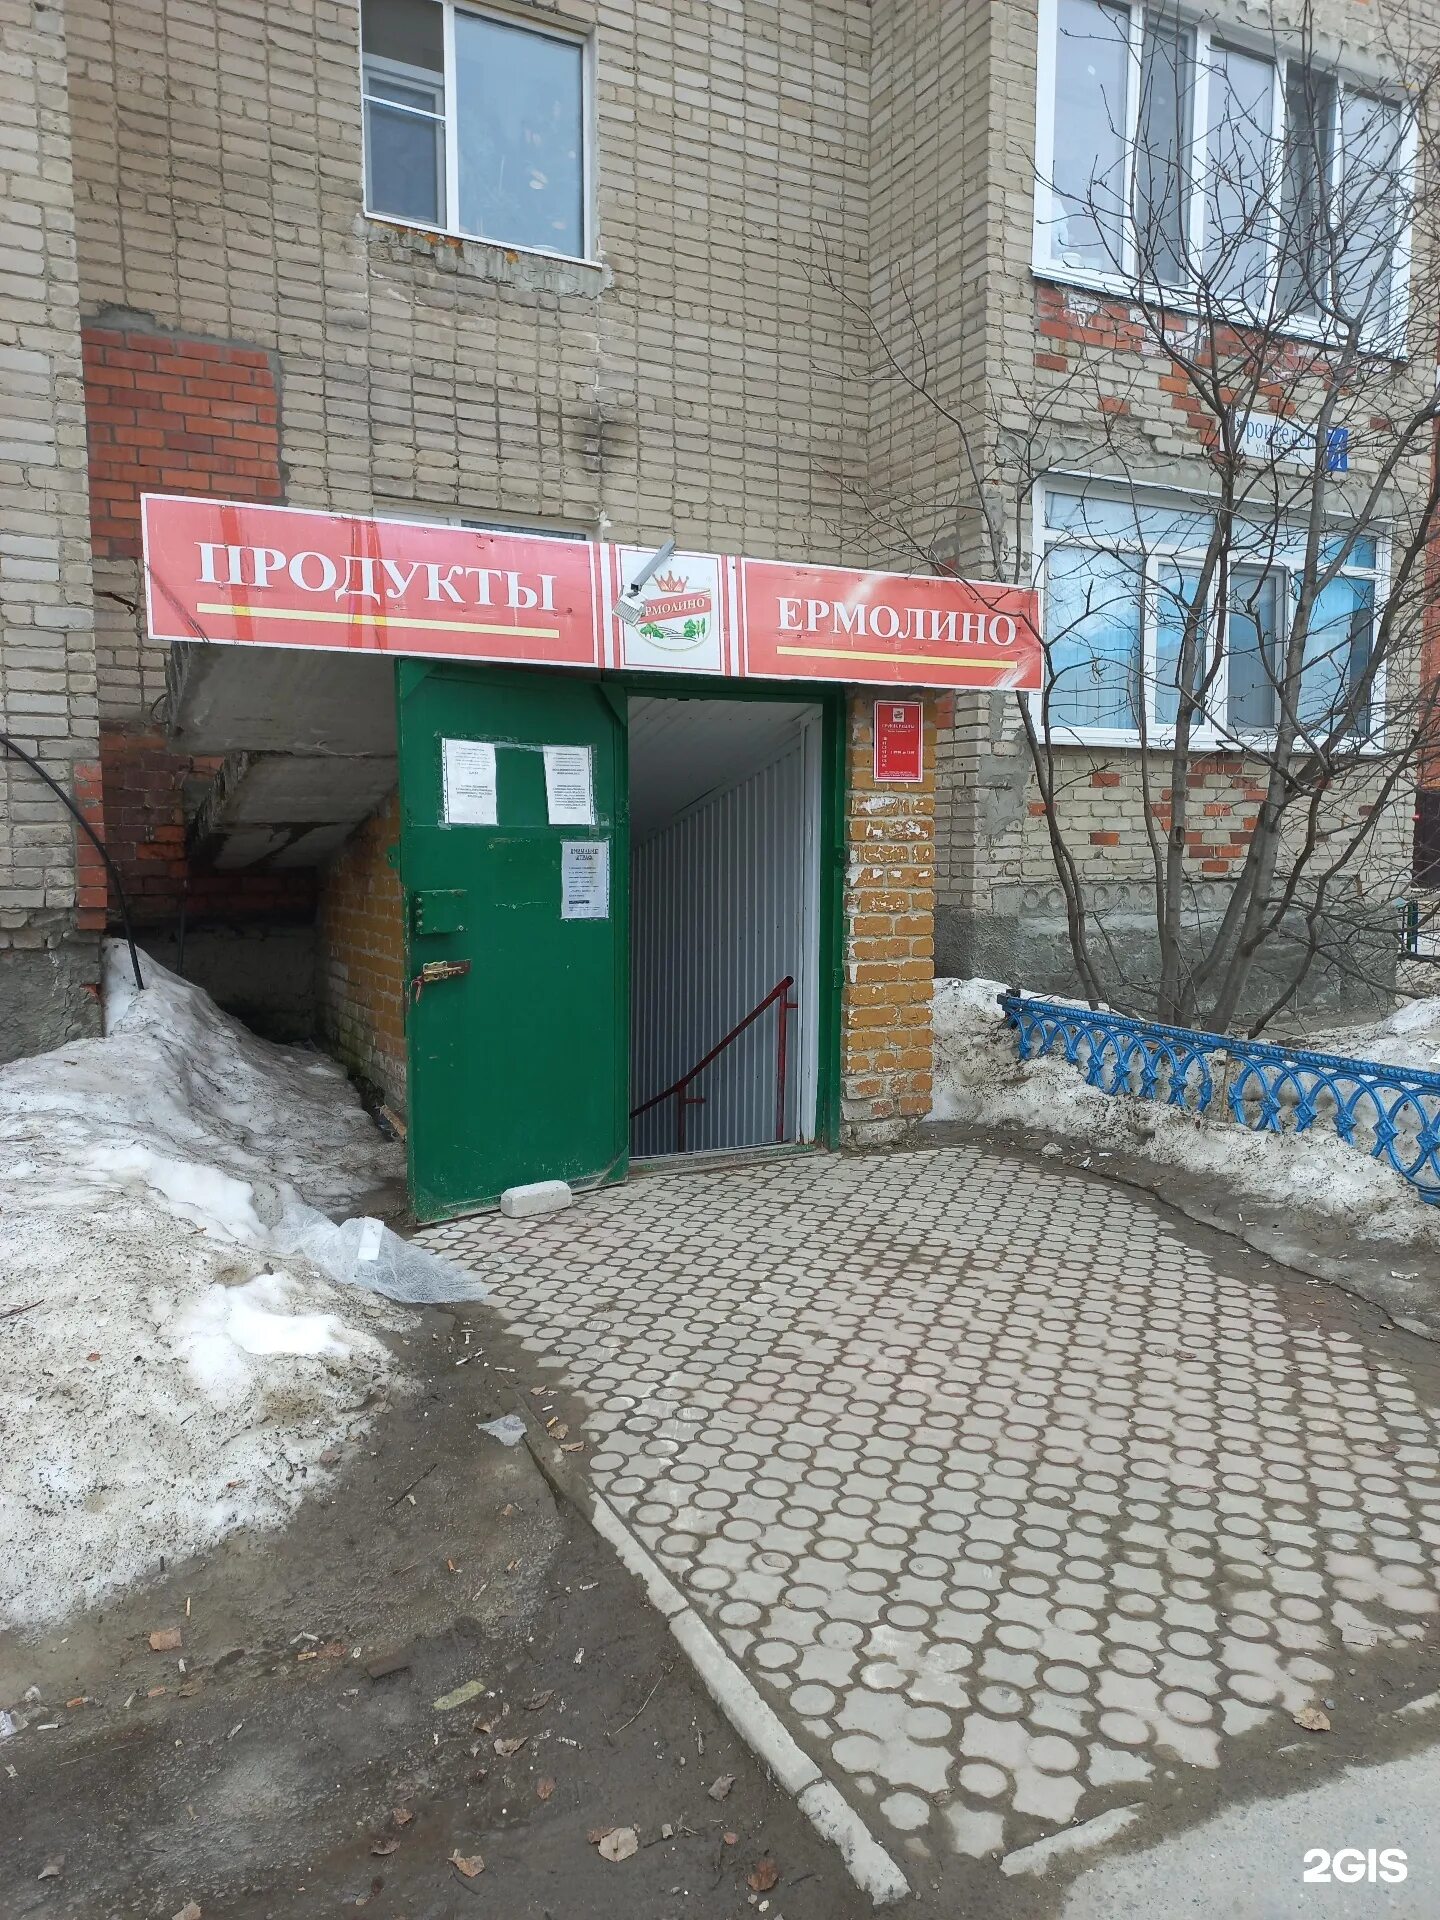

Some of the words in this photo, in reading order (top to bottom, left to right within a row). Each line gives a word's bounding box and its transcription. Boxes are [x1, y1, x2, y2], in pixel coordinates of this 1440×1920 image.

[194, 541, 559, 611] ПРОДУКТЫ
[641, 597, 706, 617] РМОЛИНО
[776, 596, 1017, 647] ЕРМОЛИНО
